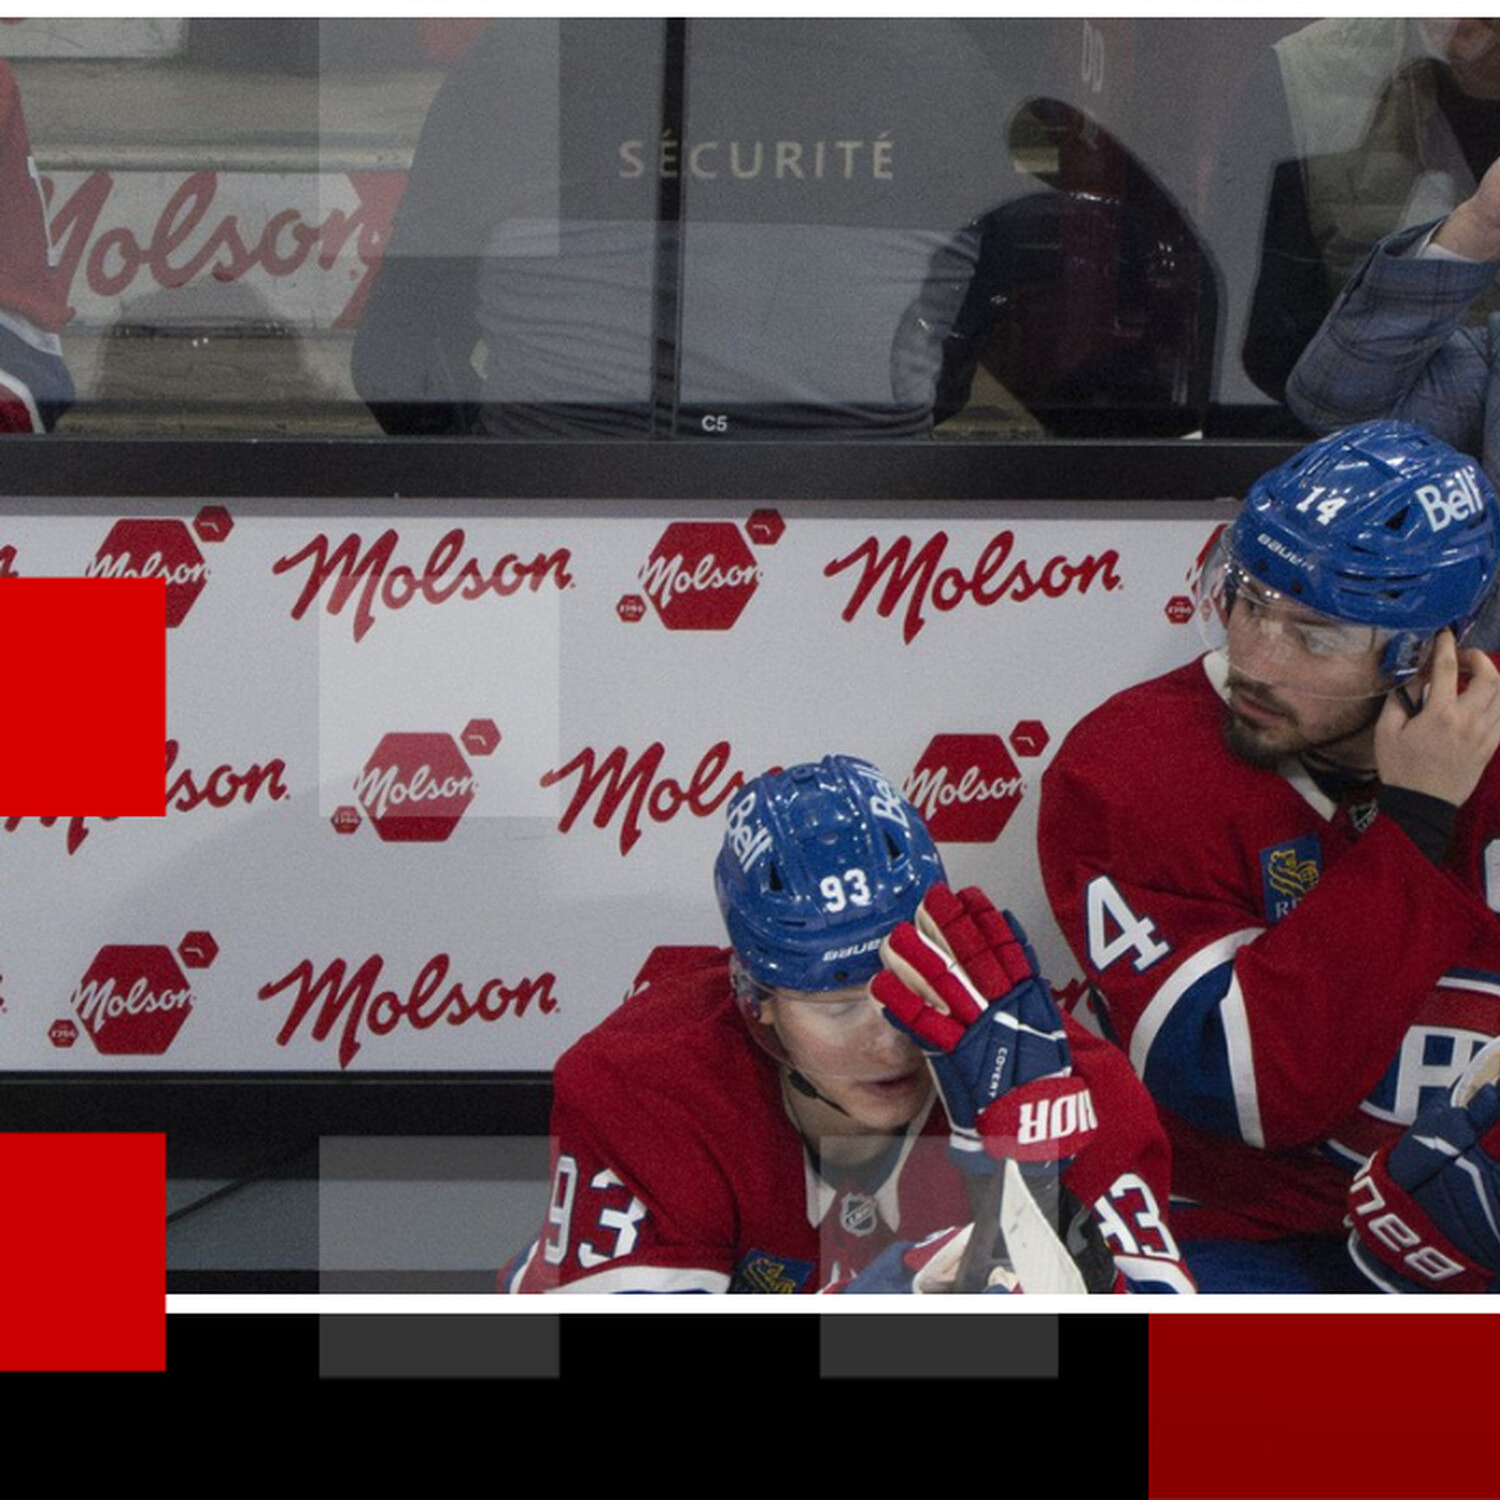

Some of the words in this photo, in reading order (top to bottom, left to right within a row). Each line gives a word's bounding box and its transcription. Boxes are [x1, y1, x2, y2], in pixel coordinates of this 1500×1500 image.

[701, 415, 728, 433] C5
[1296, 485, 1348, 526] 14
[1414, 465, 1484, 533] Bell
[272, 528, 568, 643] Molson
[637, 554, 765, 608] Molson
[823, 530, 1120, 645] Molson
[354, 762, 482, 818] Molson
[900, 767, 1031, 819] Molson
[729, 791, 773, 874] Bell
[819, 868, 872, 913] 93
[1085, 874, 1170, 974] 4
[70, 976, 197, 1033] Molson
[257, 953, 557, 1070] Molson
[989, 1046, 1009, 1099] COVERT
[543, 1155, 648, 1269] 93
